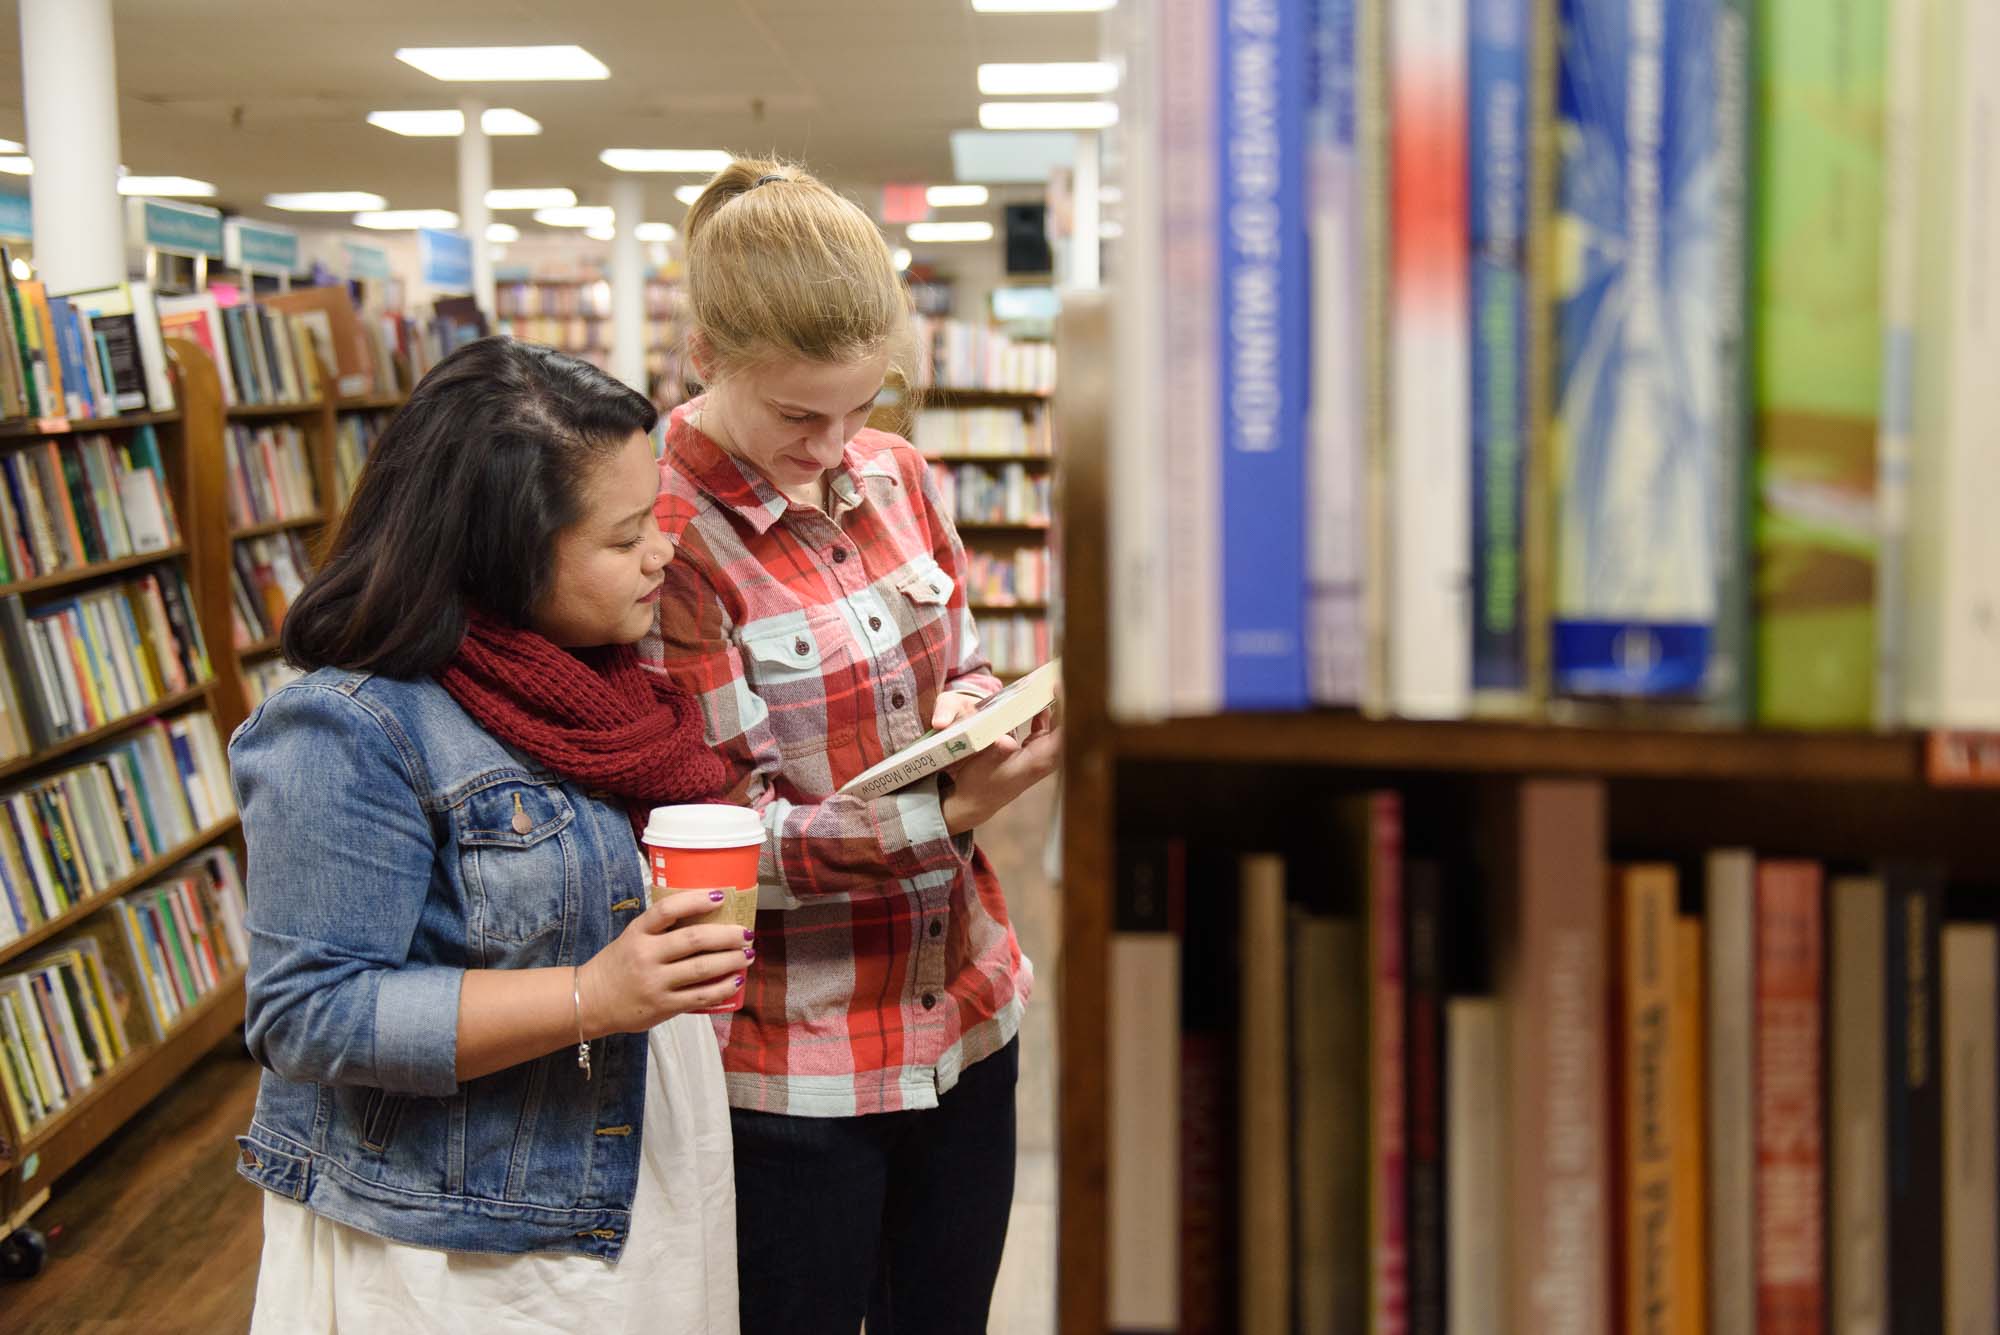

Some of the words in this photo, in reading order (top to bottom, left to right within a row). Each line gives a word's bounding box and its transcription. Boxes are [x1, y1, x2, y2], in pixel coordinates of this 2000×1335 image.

[1231, 203, 1281, 262] OF
[1231, 265, 1280, 453] MUNICH
[862, 769, 904, 795] Maddow
[904, 753, 937, 778] Rachel
